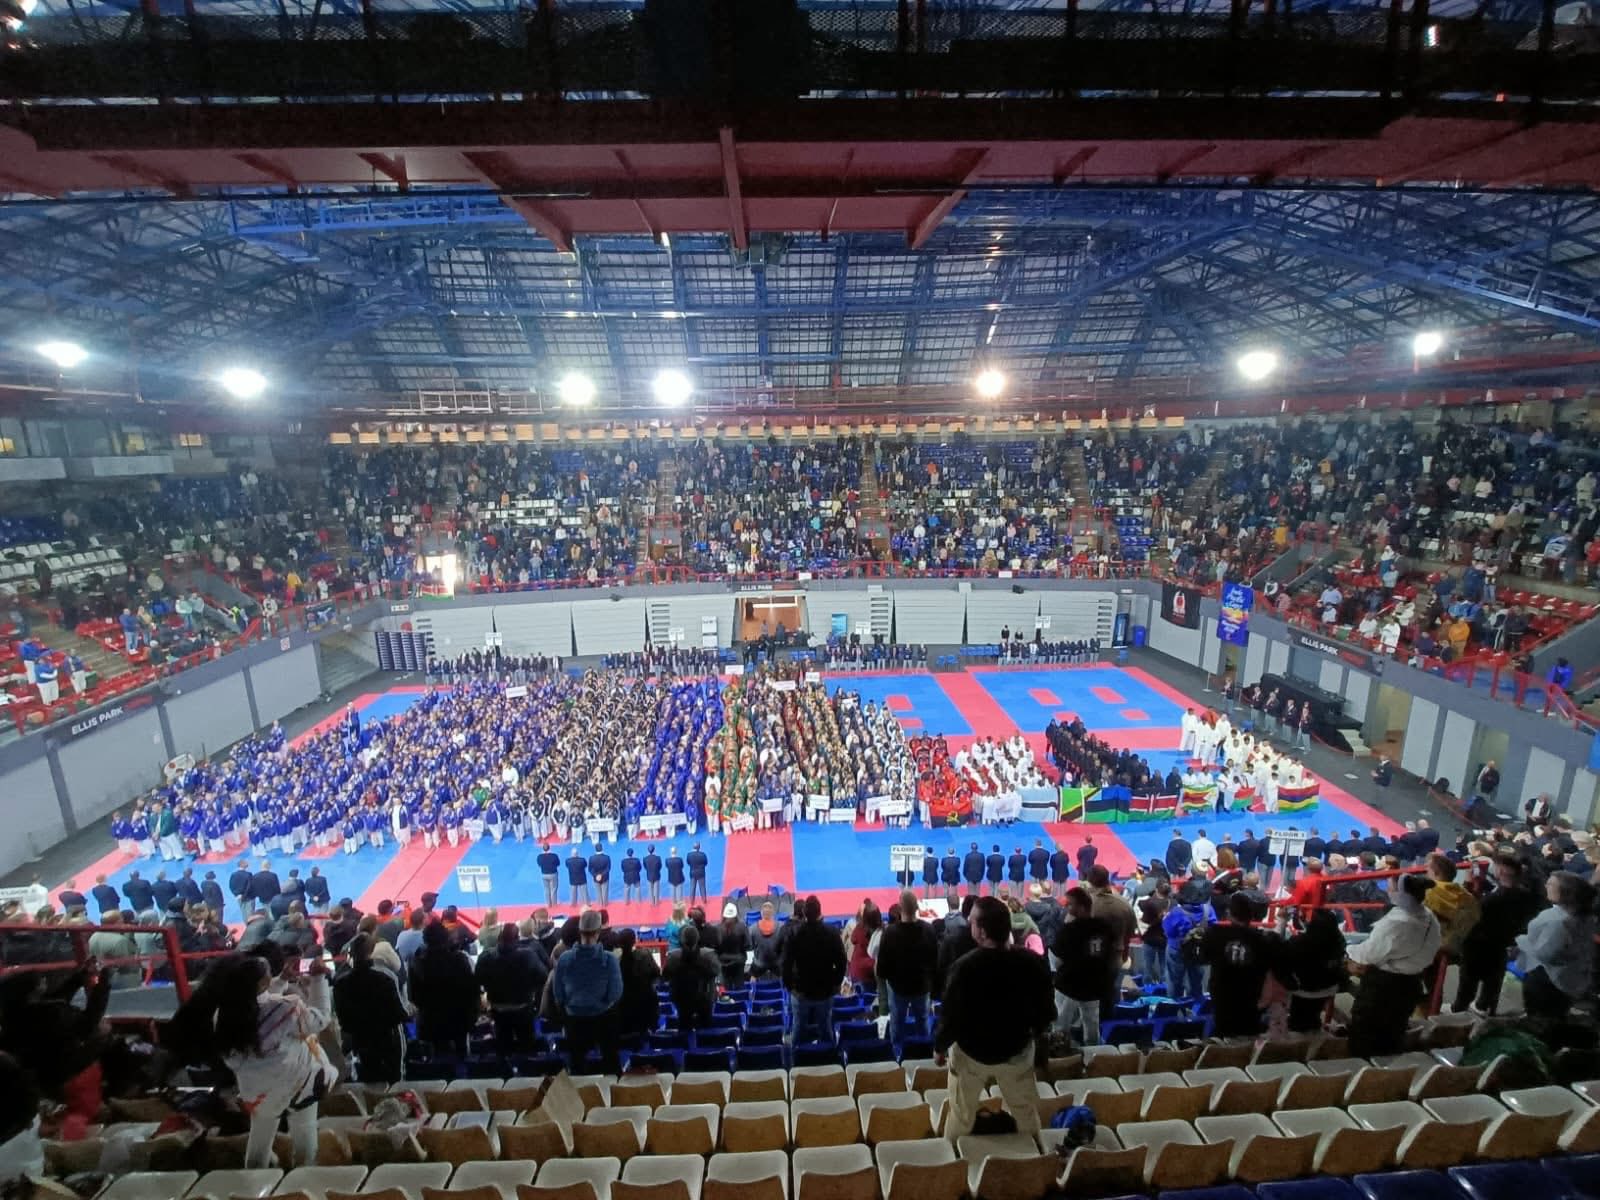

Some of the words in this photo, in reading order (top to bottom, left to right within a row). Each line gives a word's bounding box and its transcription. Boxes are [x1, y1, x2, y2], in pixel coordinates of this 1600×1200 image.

[1302, 637, 1319, 648] ELLIS
[1320, 644, 1338, 655] PARK
[71, 717, 98, 735] ELLIS
[99, 706, 124, 723] PARK
